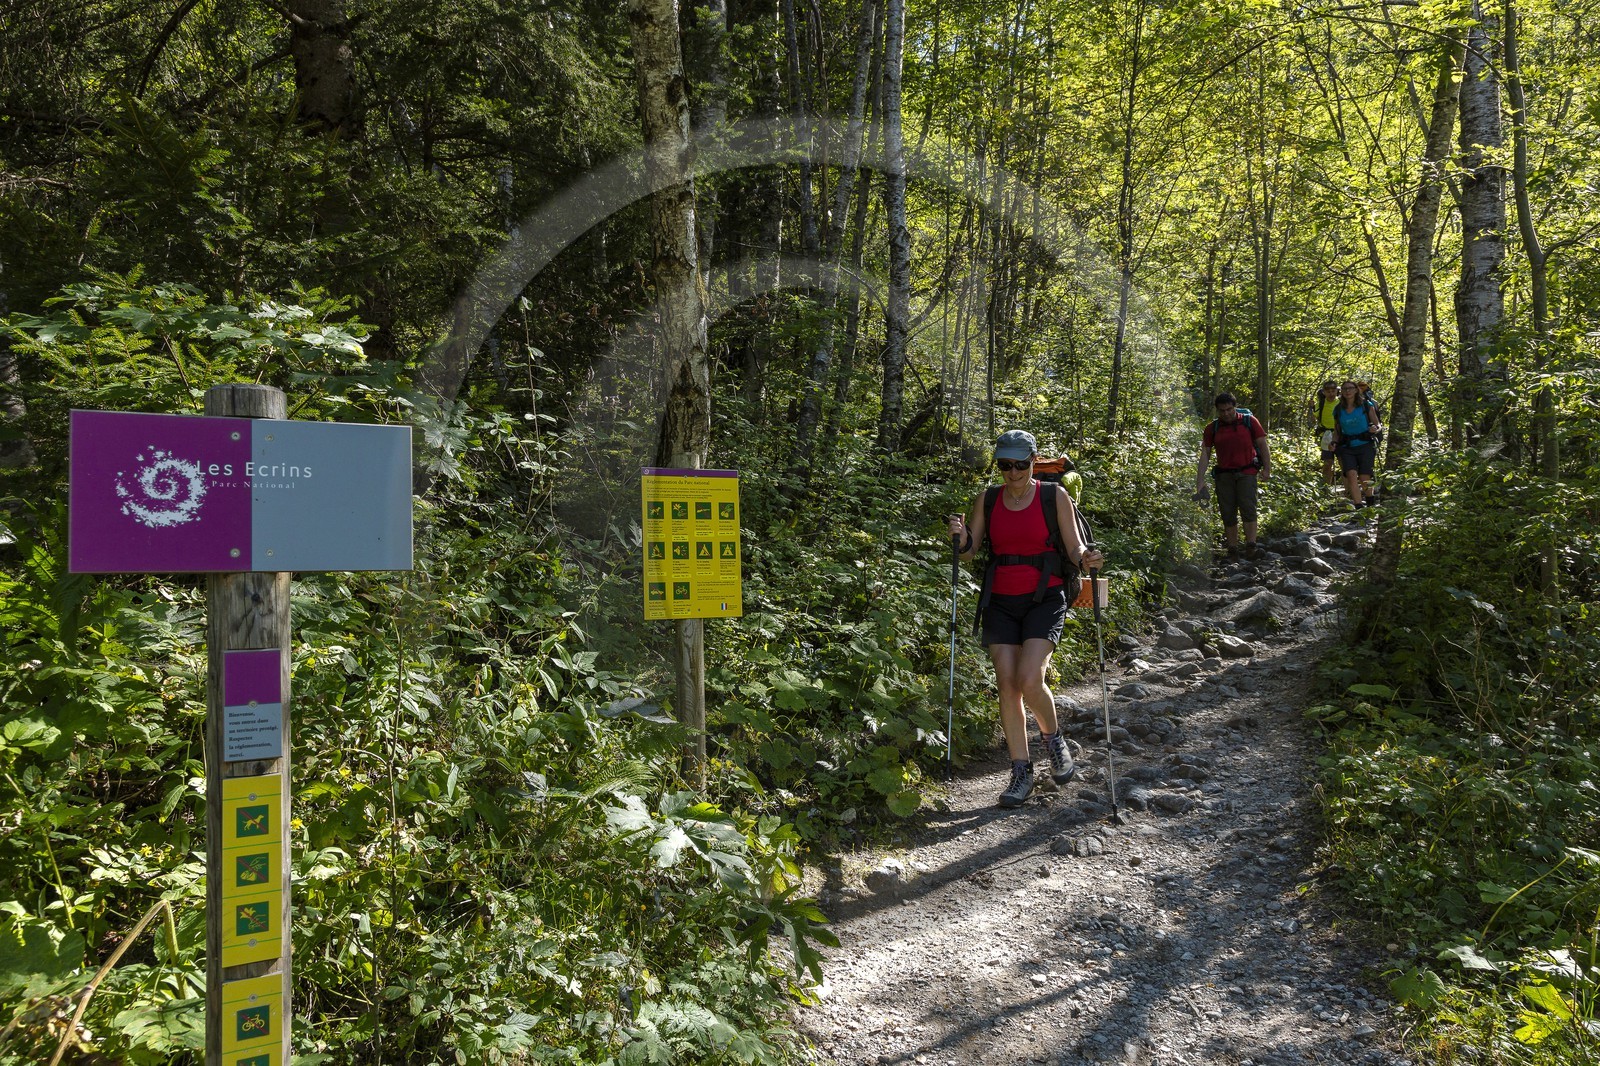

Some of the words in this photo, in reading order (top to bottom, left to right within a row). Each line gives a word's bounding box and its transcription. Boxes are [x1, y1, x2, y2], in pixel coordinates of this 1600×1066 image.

[196, 460, 233, 476] Les
[245, 462, 312, 478] Ecrins
[212, 480, 237, 488] Parc
[244, 481, 296, 489] National
